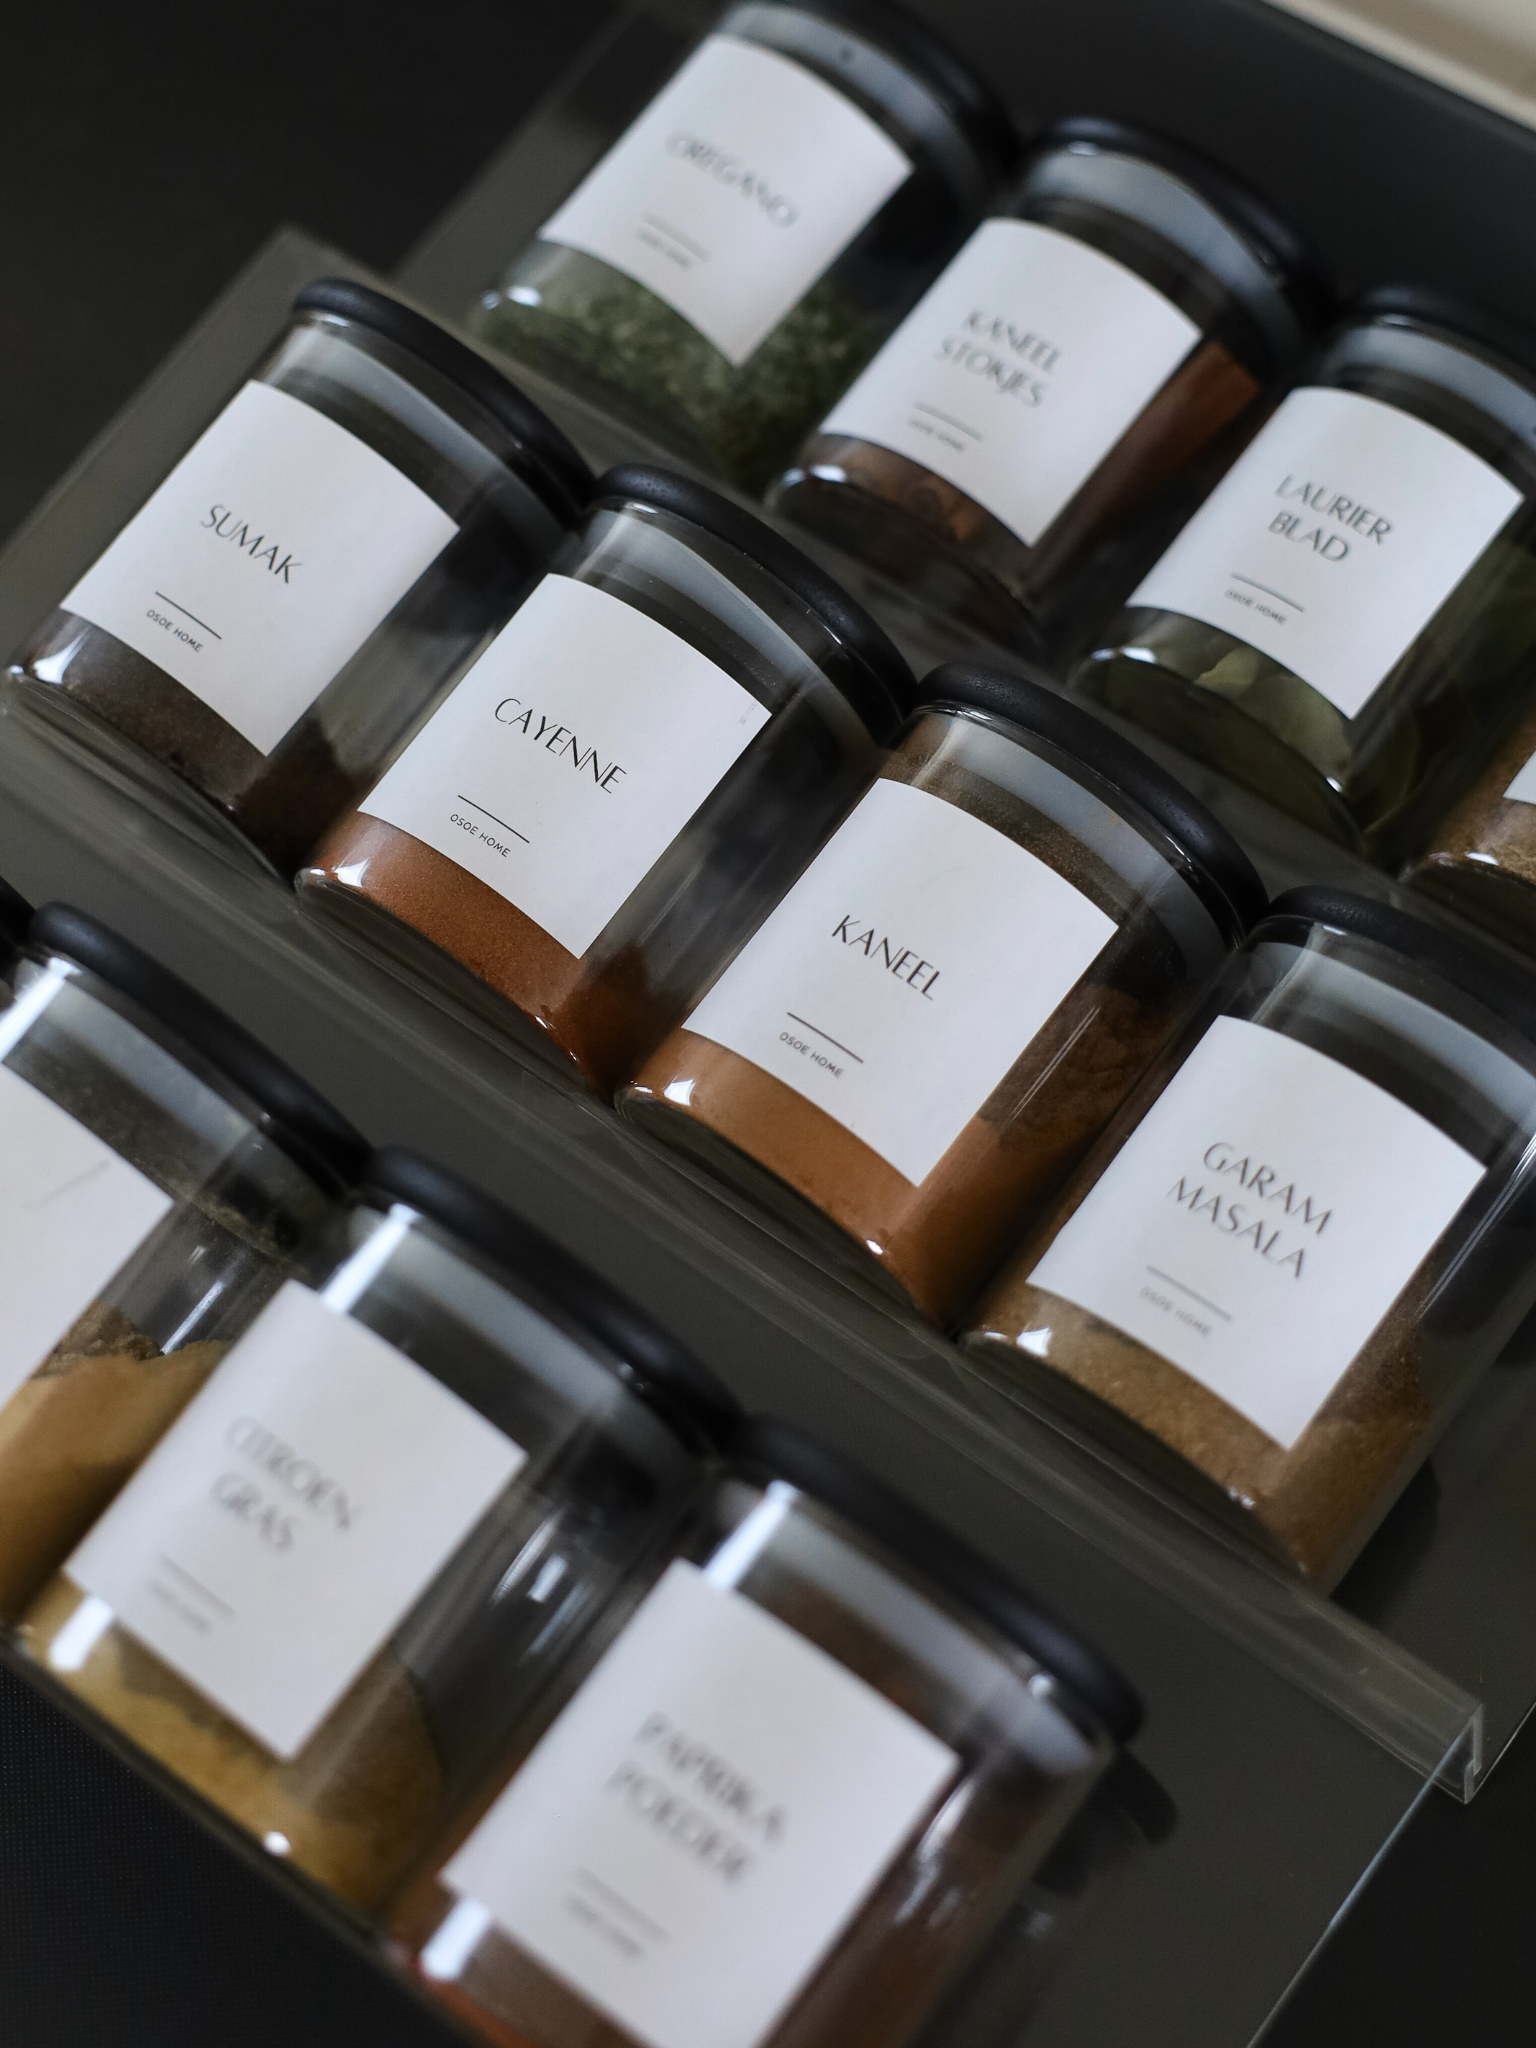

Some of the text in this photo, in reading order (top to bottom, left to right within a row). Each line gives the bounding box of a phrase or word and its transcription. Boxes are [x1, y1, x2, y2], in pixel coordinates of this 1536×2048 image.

[964, 310, 1061, 375] KANEEL
[201, 504, 302, 584] SUMAK
[1268, 511, 1350, 562] BLAD
[1276, 474, 1393, 546] LAURIER
[147, 609, 203, 653] OSOE HOME
[494, 698, 627, 794] CAYENNE
[450, 813, 511, 858] OSOE HOME
[831, 914, 940, 1001] KANEEL
[779, 1031, 844, 1079] OSOE HOME
[1203, 1142, 1332, 1235] GARAM
[1166, 1176, 1305, 1279] MASALA
